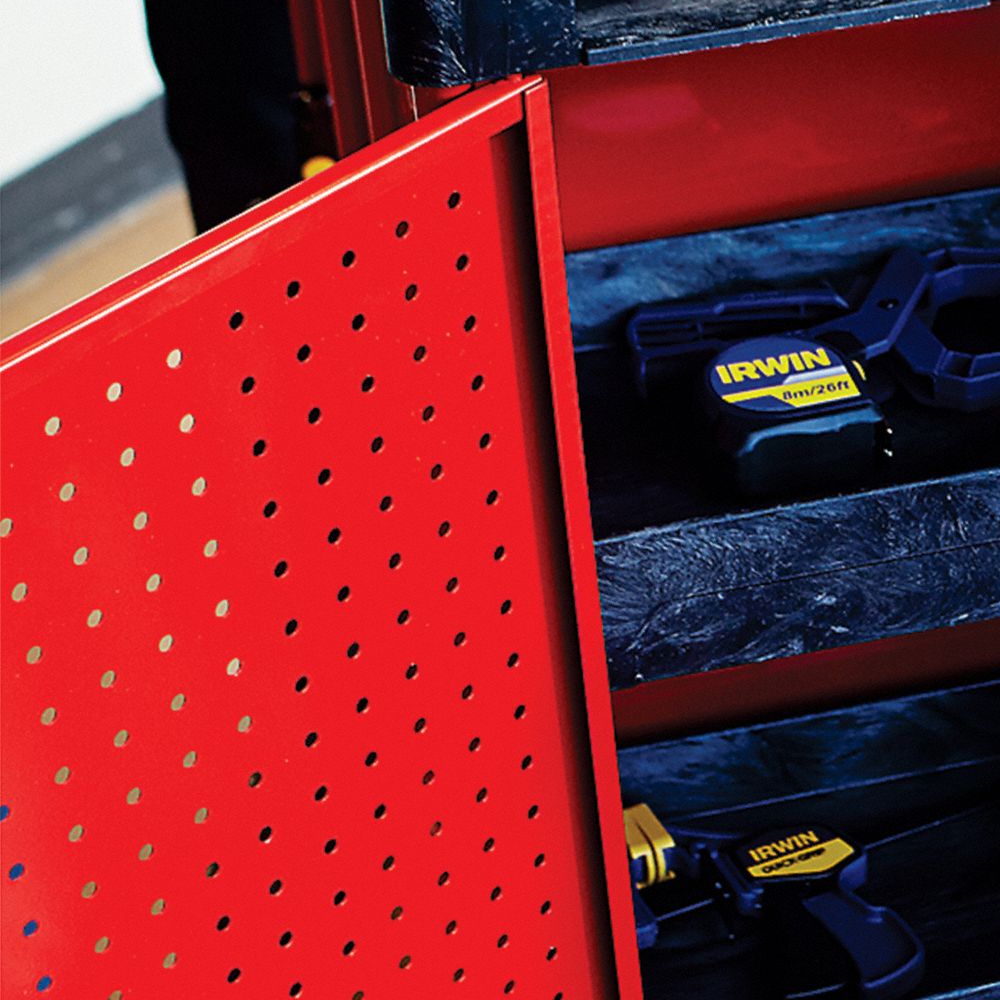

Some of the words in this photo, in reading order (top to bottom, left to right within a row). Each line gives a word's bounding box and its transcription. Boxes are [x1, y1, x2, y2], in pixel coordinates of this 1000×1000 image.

[715, 347, 831, 384] IRWIN
[782, 380, 850, 401] 8m/26ft
[748, 830, 819, 862] IRWIN
